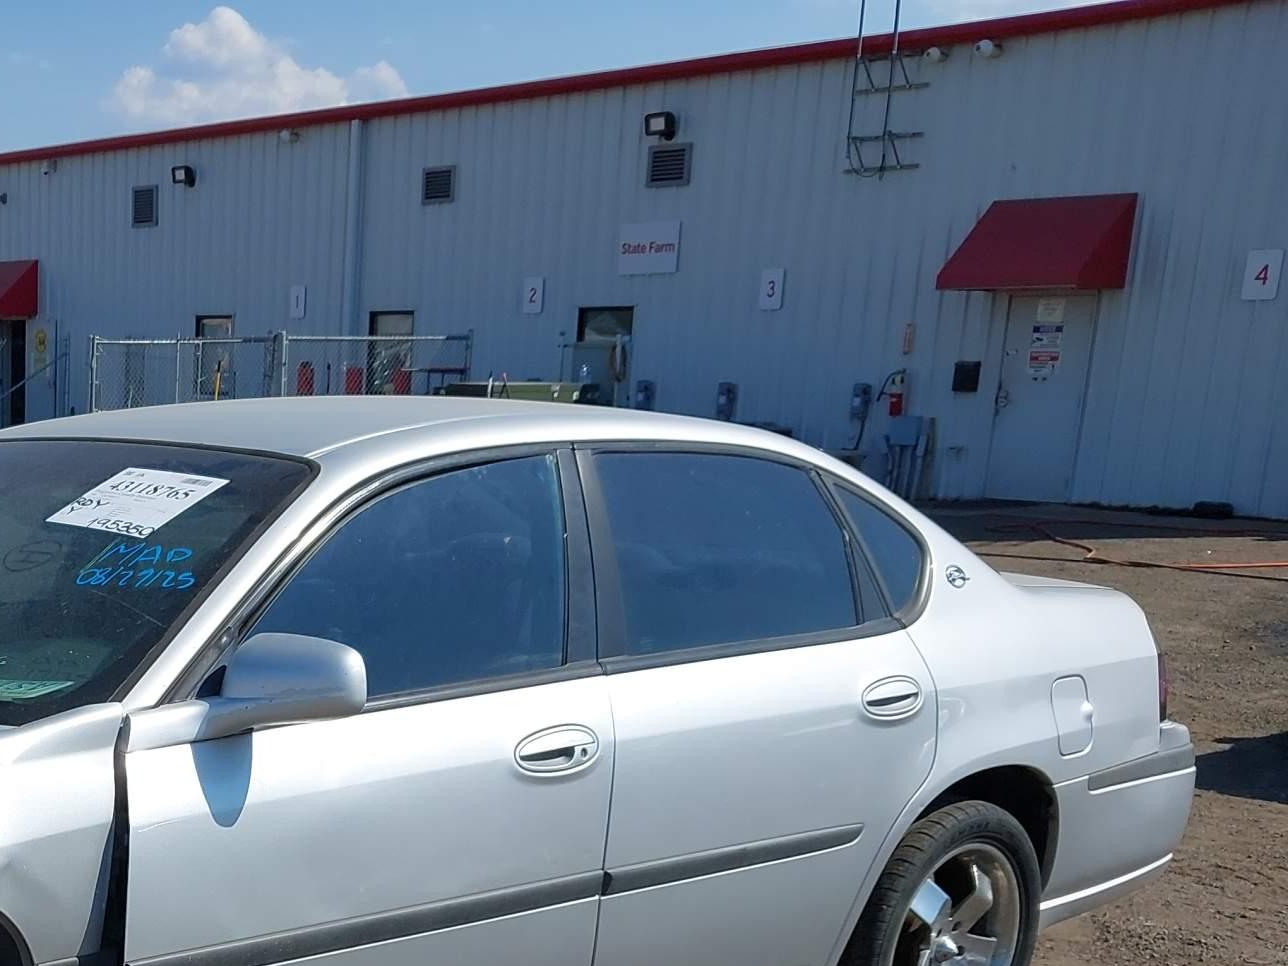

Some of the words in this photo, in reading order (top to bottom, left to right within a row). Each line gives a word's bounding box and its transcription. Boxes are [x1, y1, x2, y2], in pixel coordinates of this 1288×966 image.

[621, 242, 647, 255] State
[649, 241, 676, 253] Farm
[1254, 263, 1269, 286] 4
[529, 287, 537, 304] 2
[767, 280, 776, 298] 3
[110, 479, 197, 501] 43118765
